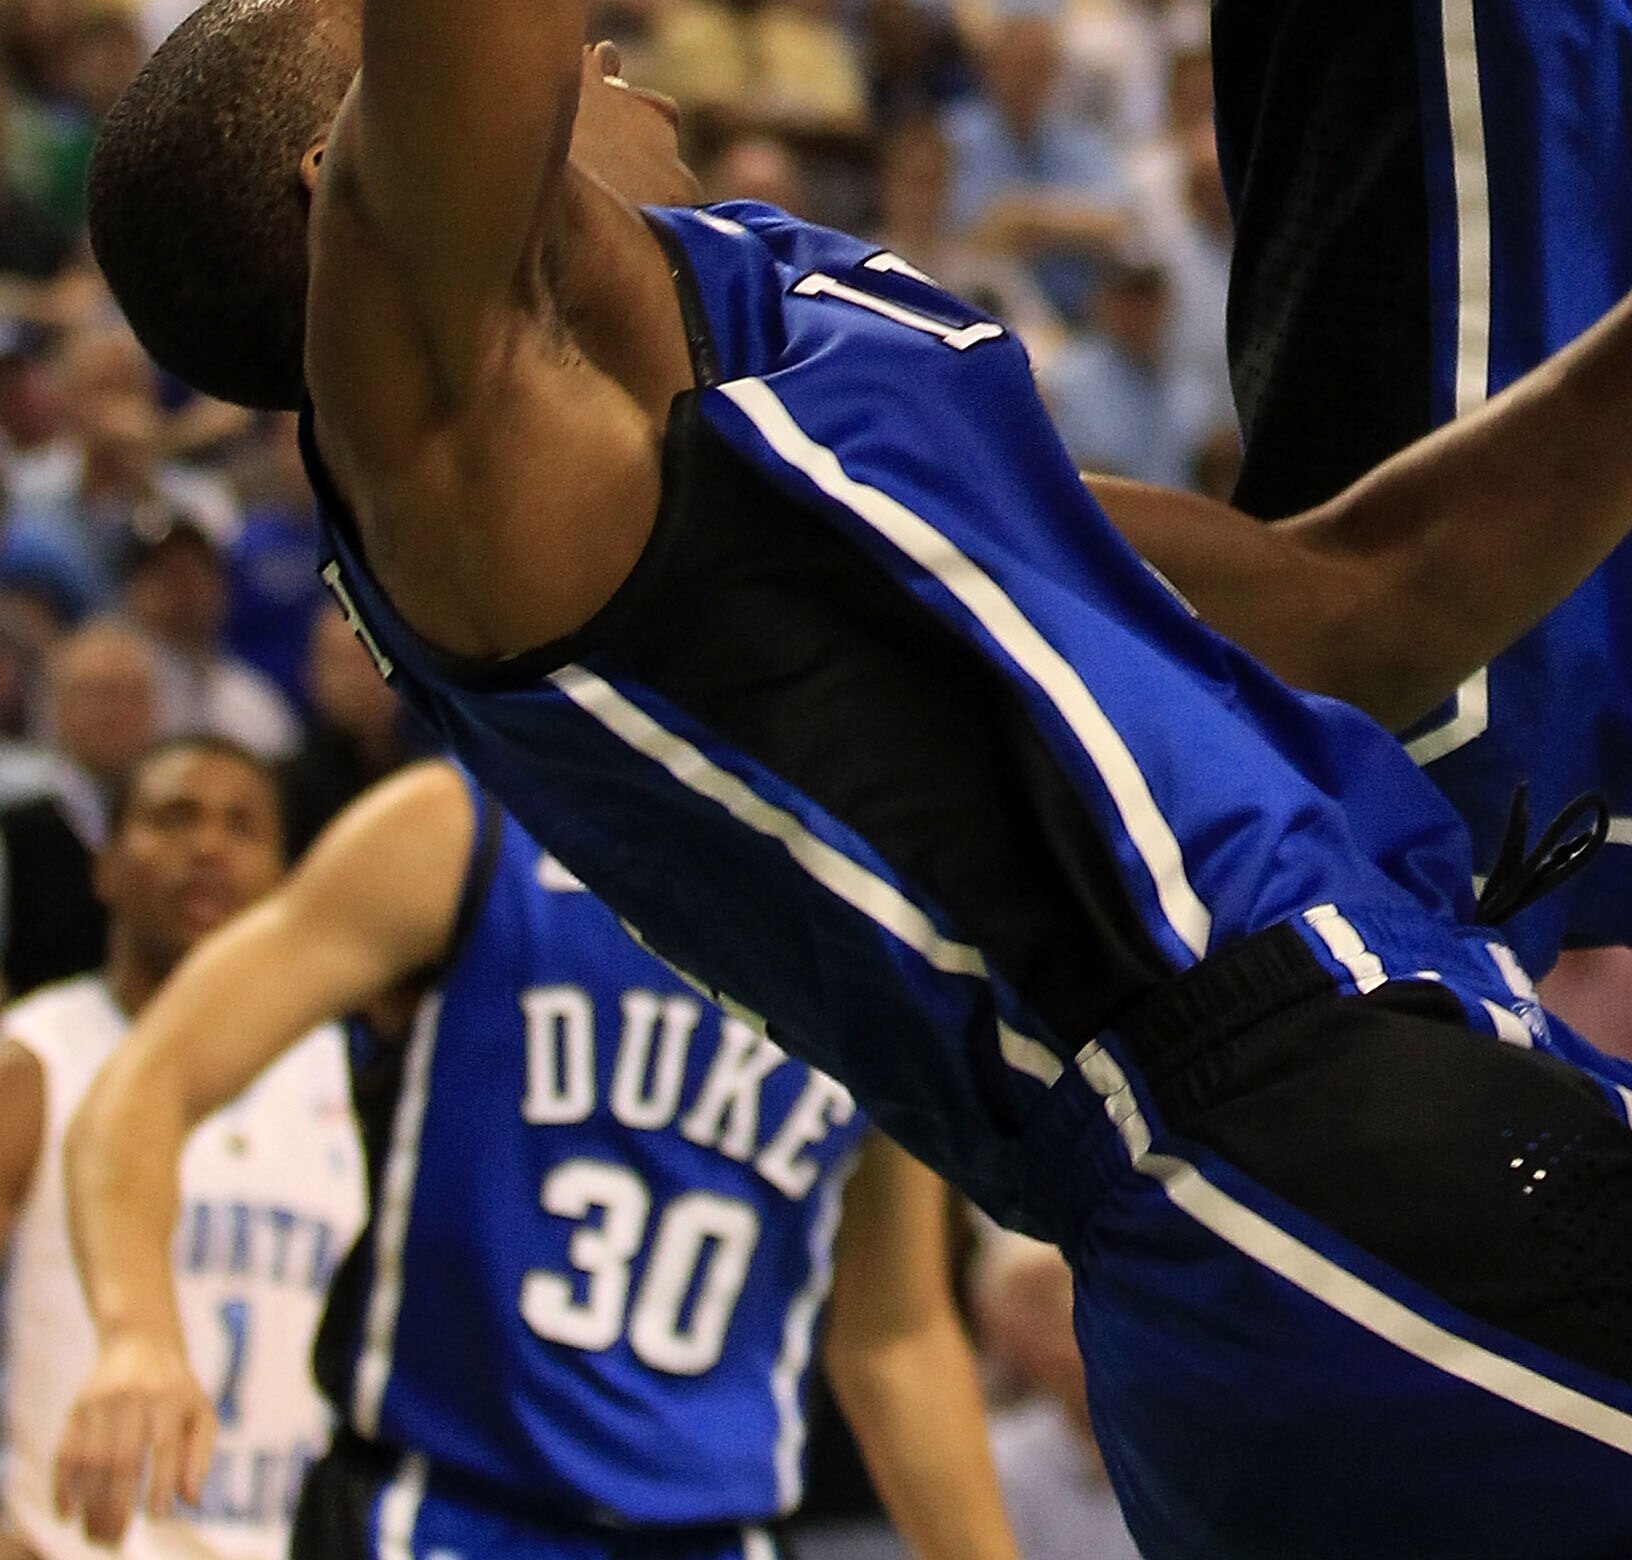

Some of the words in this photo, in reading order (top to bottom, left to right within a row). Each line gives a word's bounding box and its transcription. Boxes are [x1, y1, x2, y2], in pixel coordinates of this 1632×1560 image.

[519, 984, 857, 1201] DUKE
[216, 1300, 248, 1424] 1
[518, 1156, 761, 1376] 30
